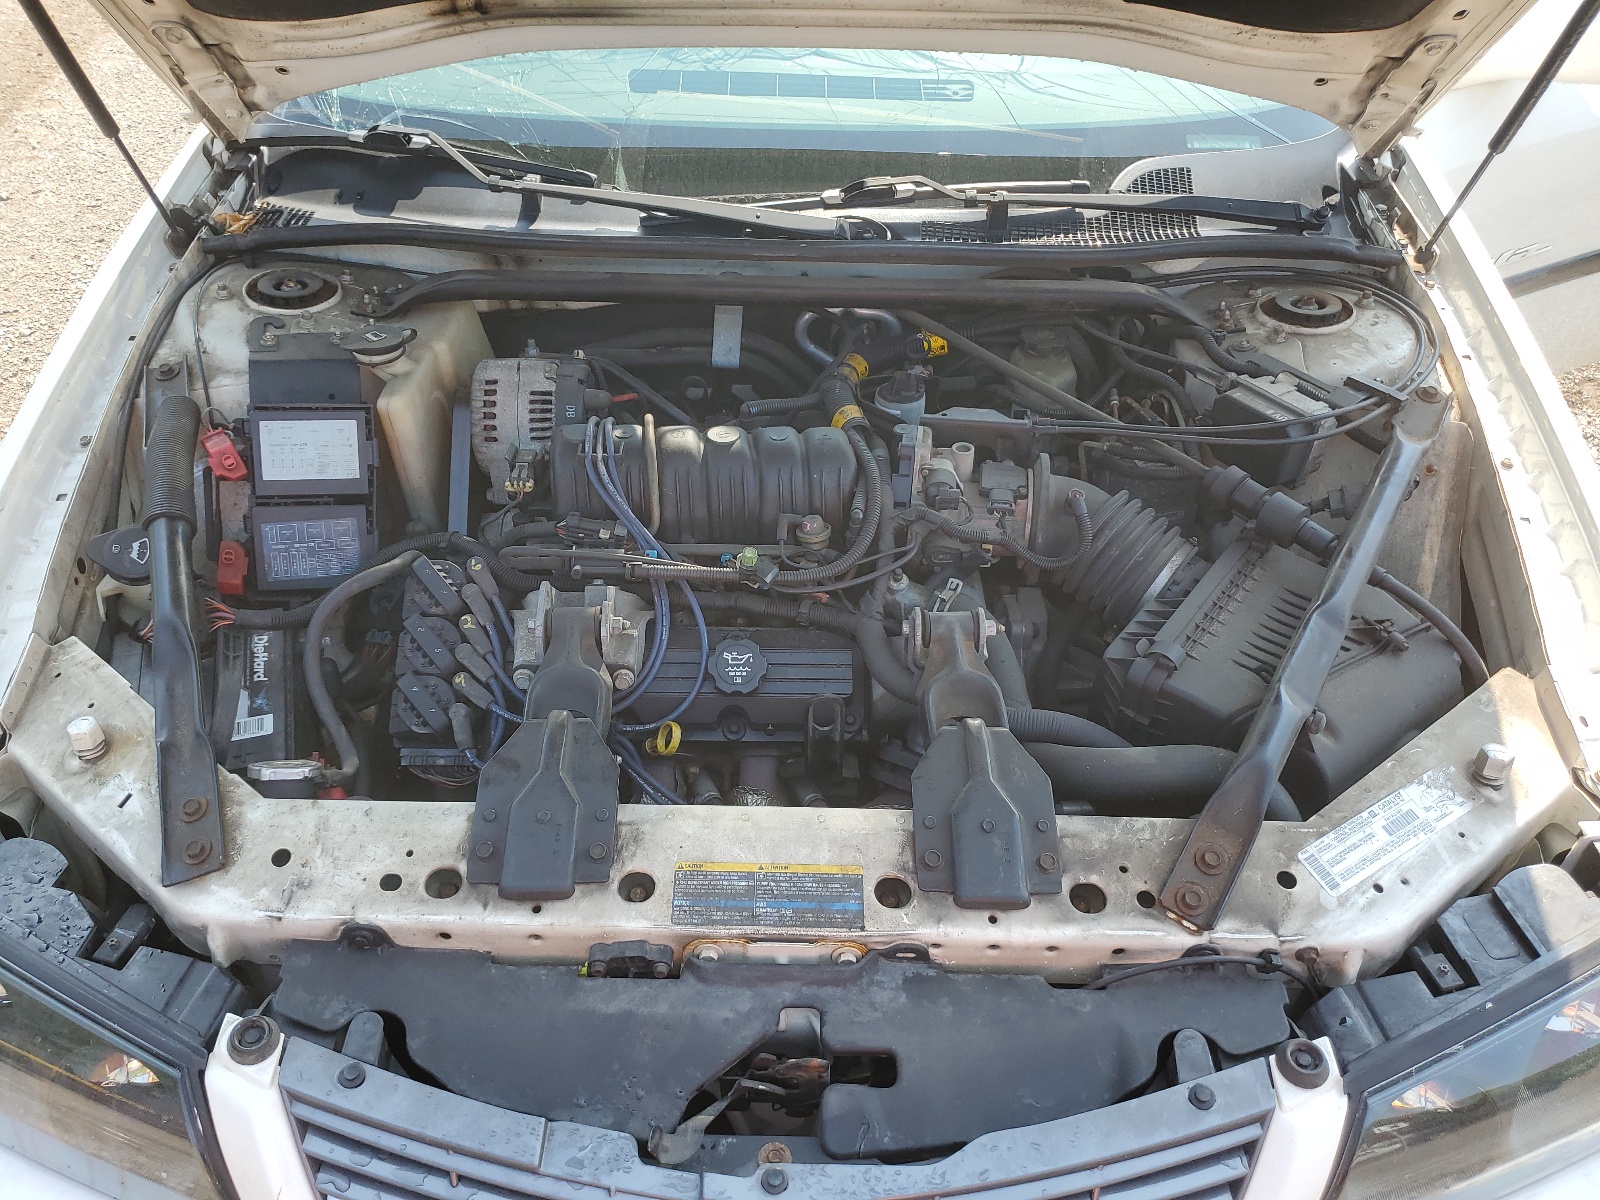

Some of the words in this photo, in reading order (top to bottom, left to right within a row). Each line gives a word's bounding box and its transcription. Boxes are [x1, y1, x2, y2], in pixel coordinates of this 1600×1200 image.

[565, 405, 576, 418] DB
[460, 614, 476, 629] 2
[253, 635, 268, 682] DieHard
[1377, 791, 1403, 811] CATALYST
